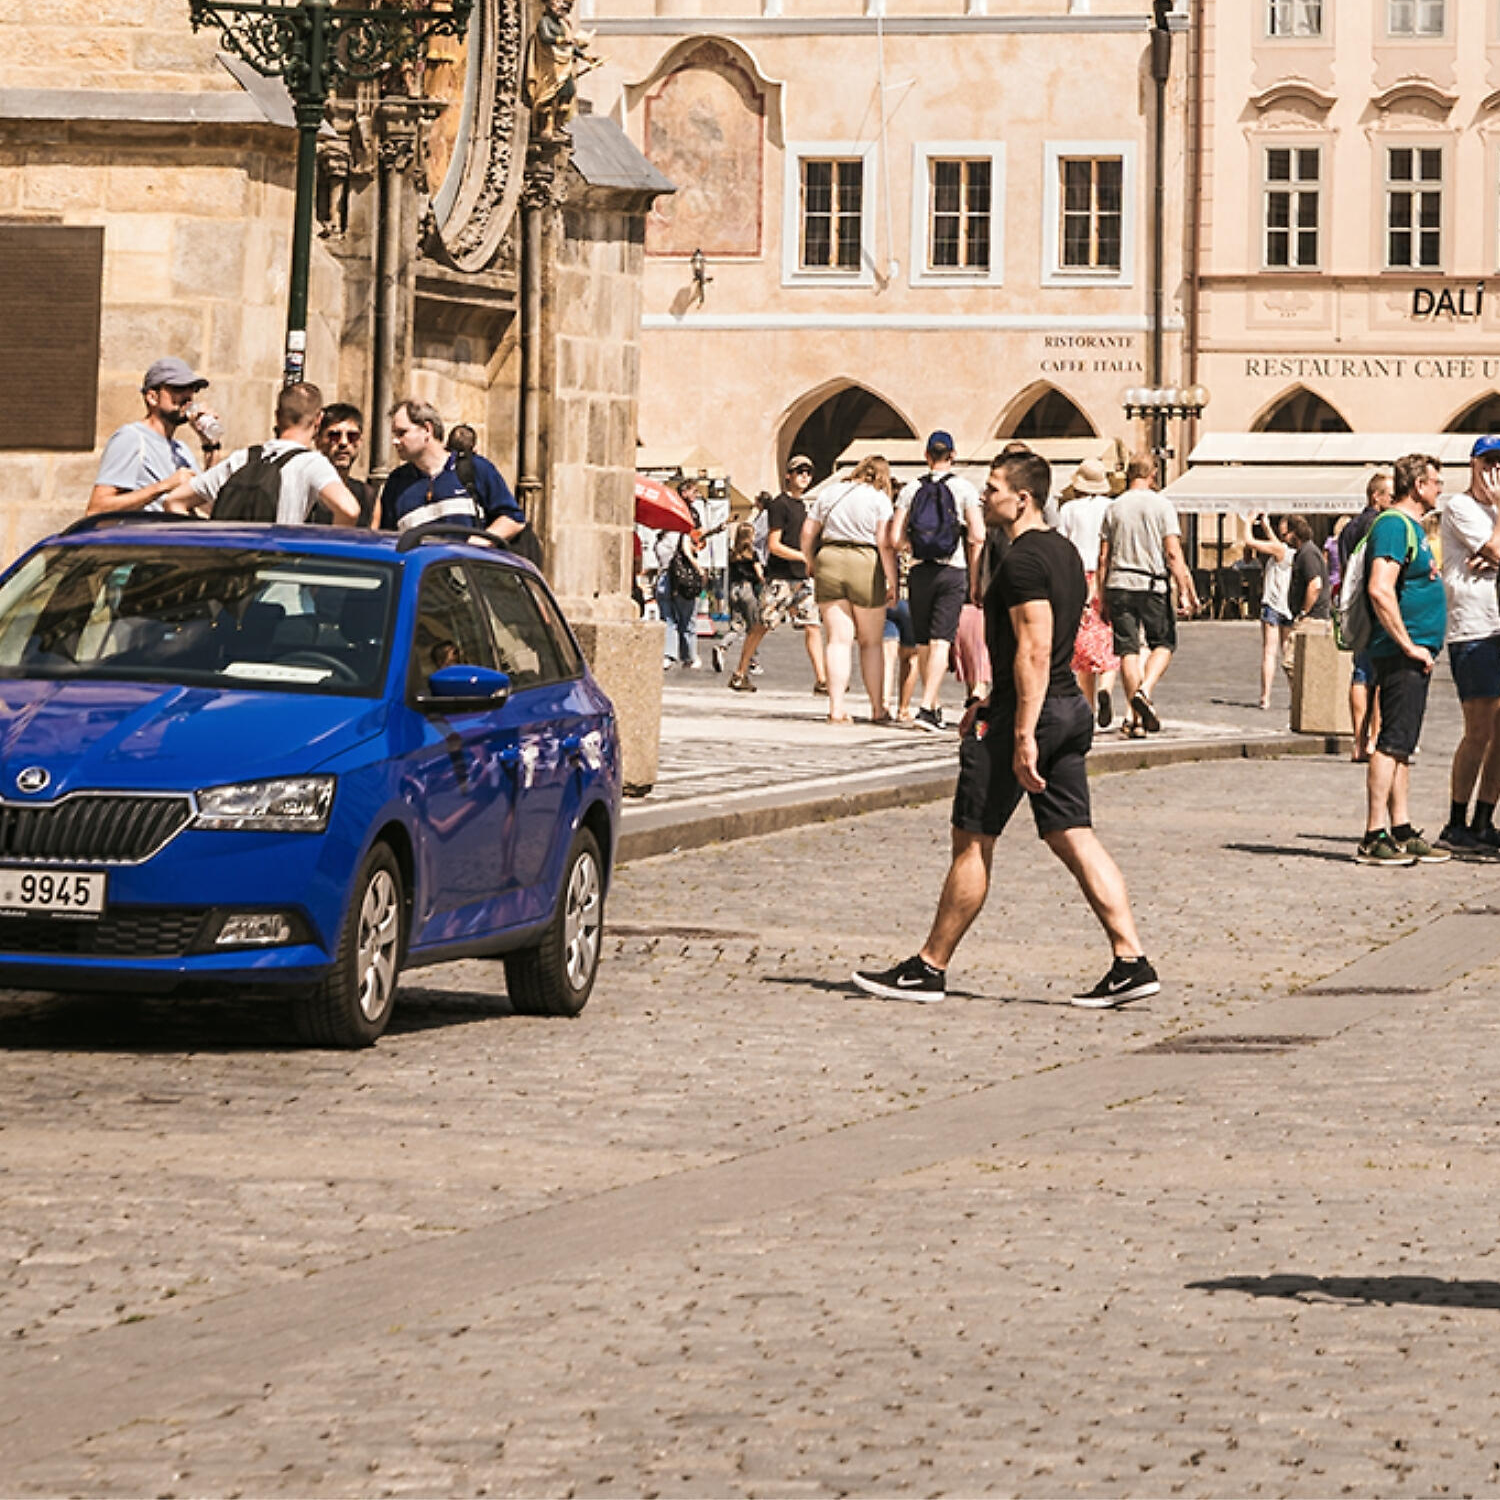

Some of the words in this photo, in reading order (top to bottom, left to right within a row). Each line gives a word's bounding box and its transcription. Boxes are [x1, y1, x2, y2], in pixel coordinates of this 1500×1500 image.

[1044, 335, 1134, 348] RISTORANTE
[1093, 360, 1143, 372] ITALIA
[1245, 358, 1408, 378] RESTAURANT
[1483, 360, 1500, 379] U
[20, 875, 91, 906] 9945
